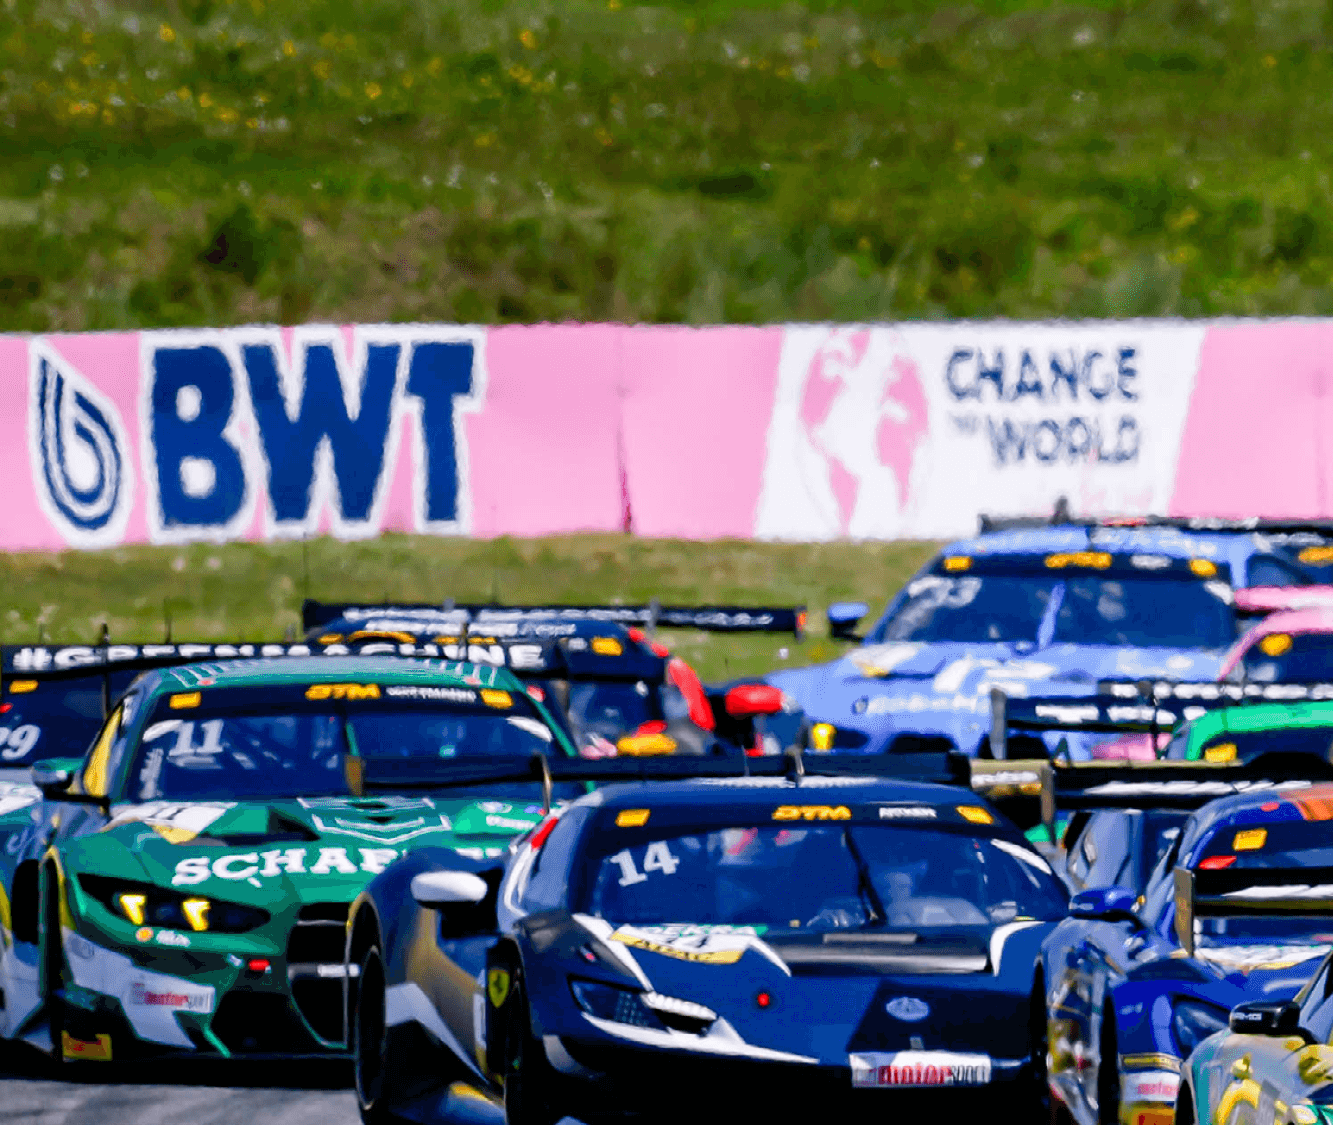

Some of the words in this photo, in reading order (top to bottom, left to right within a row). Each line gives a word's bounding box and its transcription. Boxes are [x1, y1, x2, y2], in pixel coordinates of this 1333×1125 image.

[947, 345, 1138, 400] CHANGE
[151, 341, 477, 525] BWT
[987, 416, 1139, 464] WORLD
[305, 683, 381, 701] DTM
[168, 718, 224, 756] 11
[772, 804, 852, 821] DTM
[610, 840, 681, 887] 14
